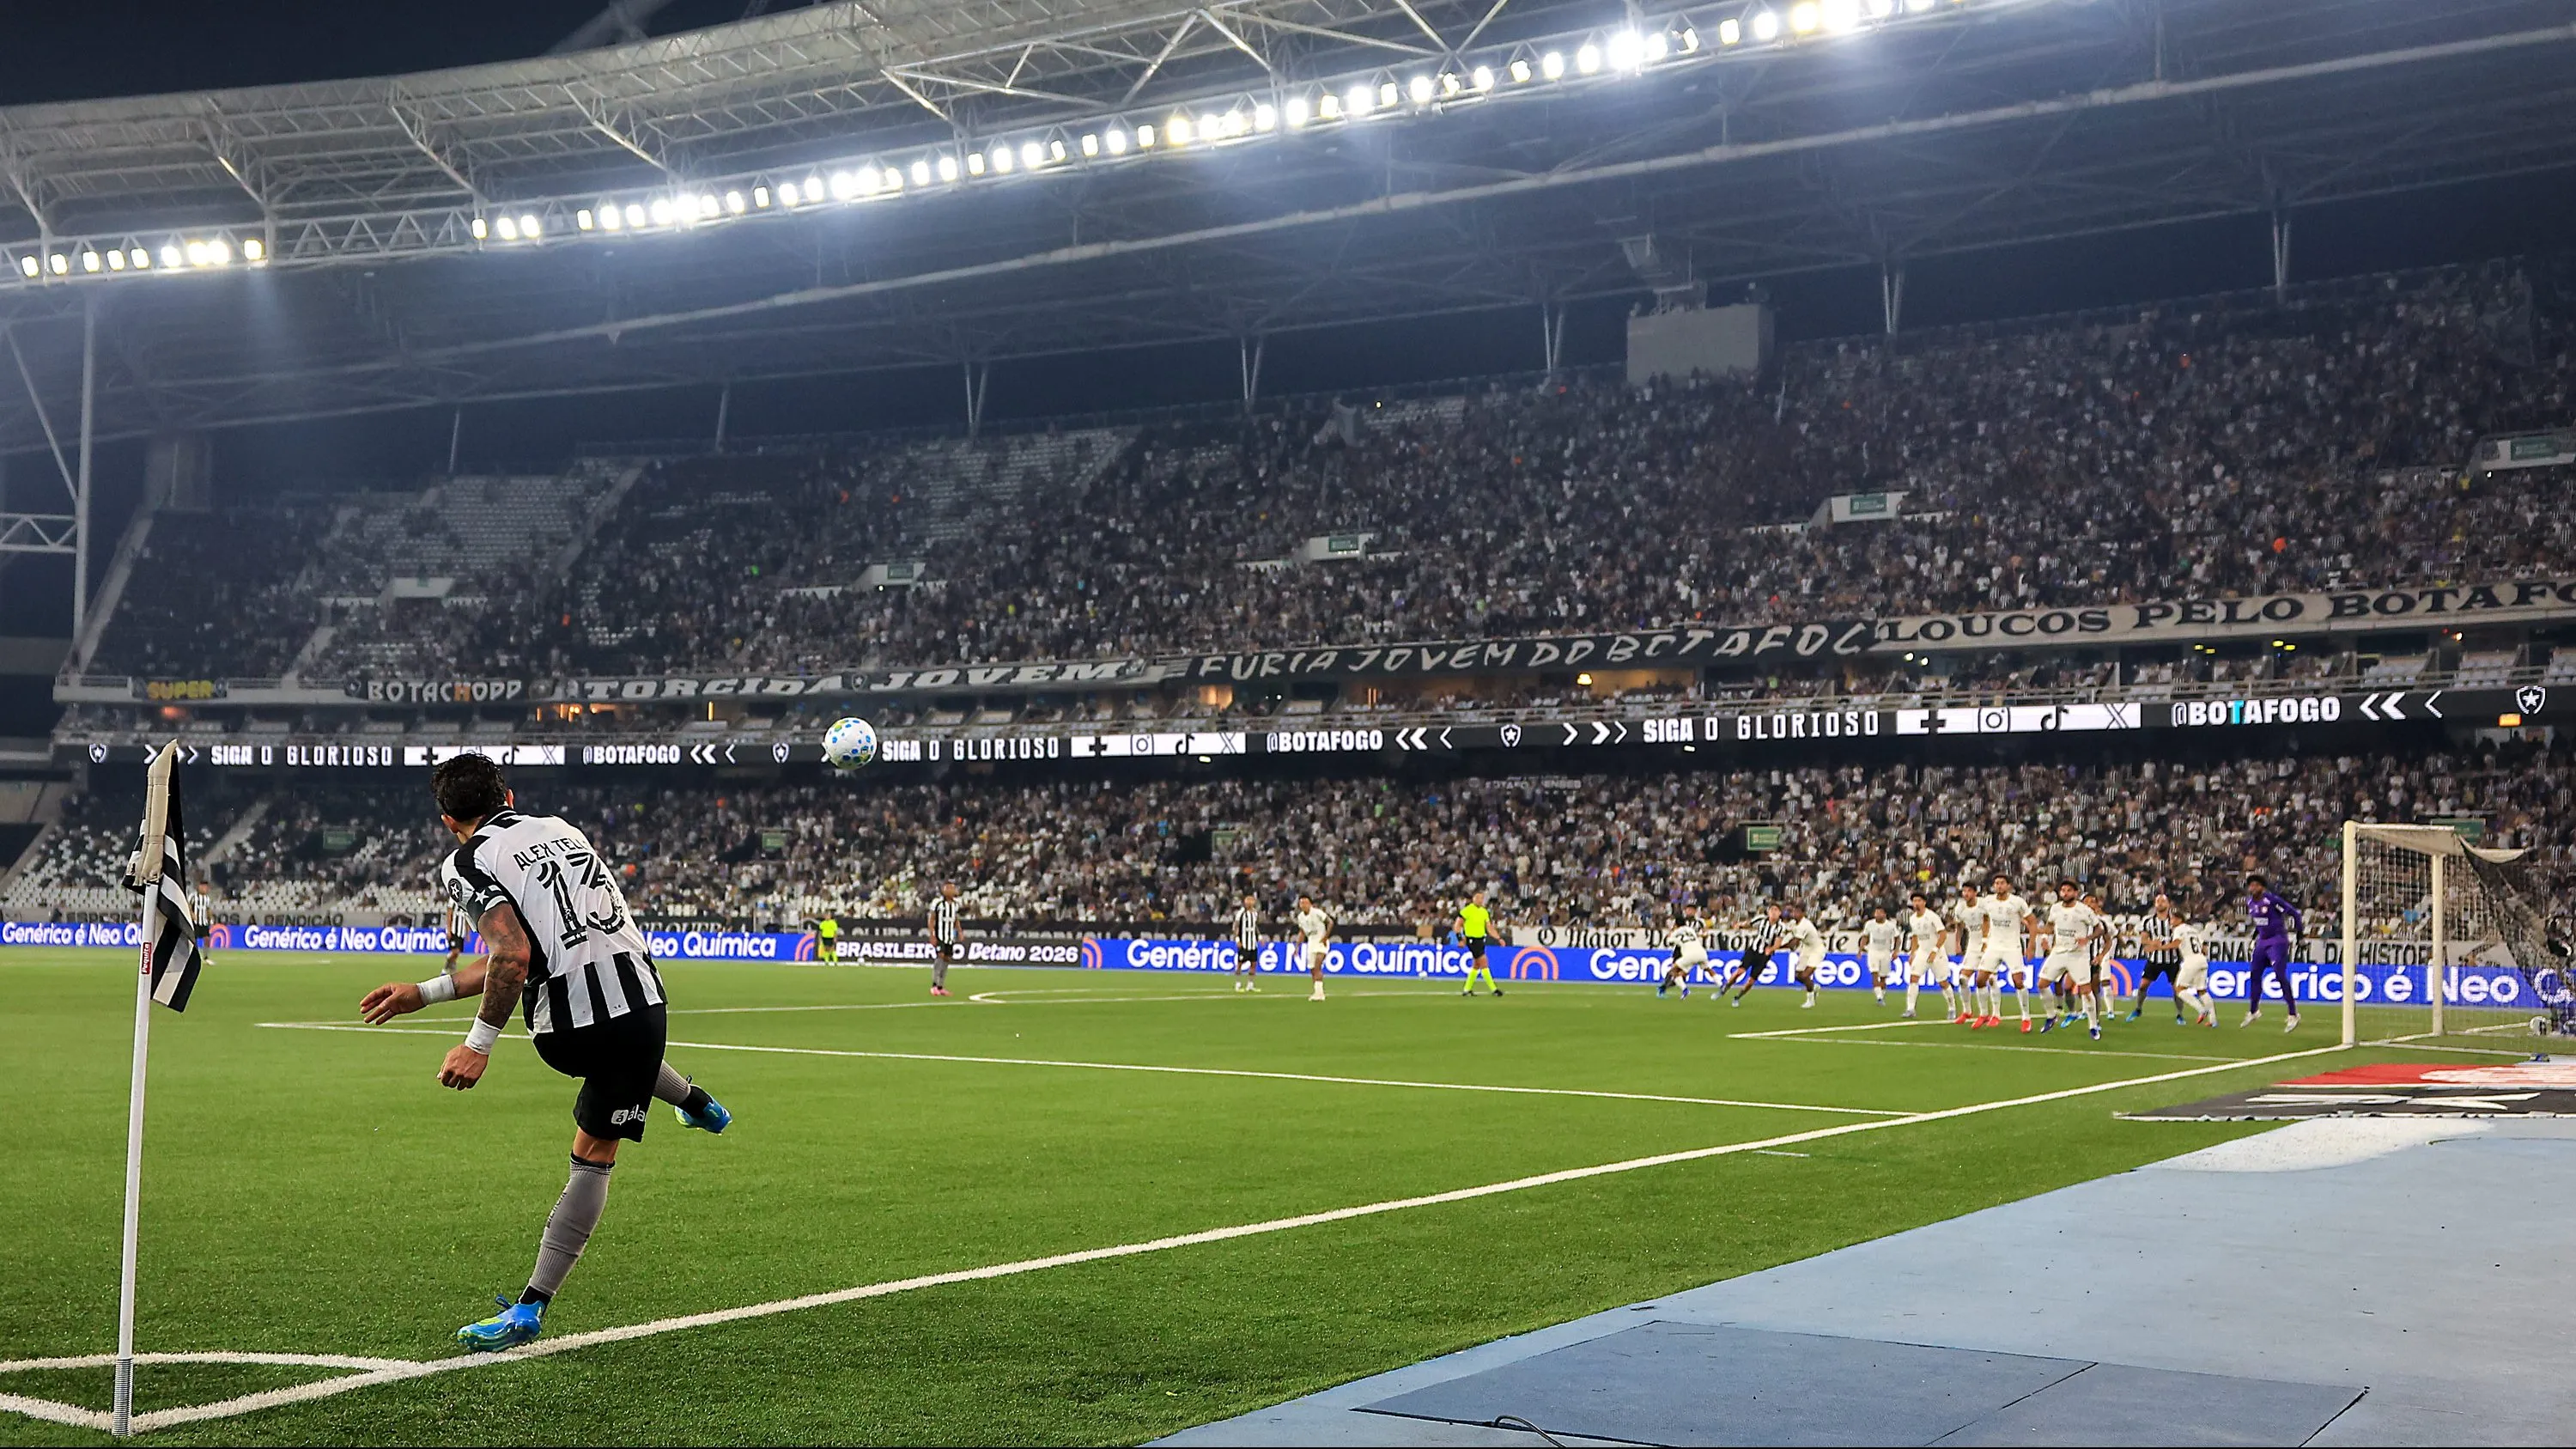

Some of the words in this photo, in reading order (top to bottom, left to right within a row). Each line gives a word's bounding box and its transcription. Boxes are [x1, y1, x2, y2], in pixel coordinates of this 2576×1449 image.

[1886, 608, 2111, 642] LOUCOS
[2133, 597, 2305, 629] PELO
[1199, 650, 1340, 680] FURIA
[1348, 642, 1518, 673] JOVEM
[147, 680, 214, 699] SUPER
[368, 679, 522, 703] BOTACHOPP
[584, 674, 845, 700] TORCIDA
[869, 661, 1127, 691] JOVEM
[2171, 695, 2342, 727] @BOTAFOGO
[1643, 716, 1694, 744] SIGA
[1705, 716, 1718, 742] O
[1737, 710, 1880, 740] GLORIOSO
[582, 744, 681, 765] @BOTAFOGO
[882, 739, 921, 762] SIGA
[929, 739, 940, 761] O
[953, 736, 1059, 761] GLORIOSO
[1267, 729, 1383, 754] @BOTAFOGO
[210, 745, 253, 767] SIGA
[260, 746, 273, 766] O
[286, 746, 393, 767] GLORIOSO
[513, 843, 556, 871] ALEX
[536, 850, 625, 951] 13
[3, 922, 71, 944] Genérico
[88, 923, 121, 944] Neo
[244, 925, 322, 949] Genérico
[340, 928, 375, 950] Neo
[380, 926, 450, 953] Químic
[683, 931, 777, 958] Química
[835, 941, 965, 959] BRASILEIRO
[968, 942, 1026, 961] Betano
[1029, 946, 1078, 962] 2026
